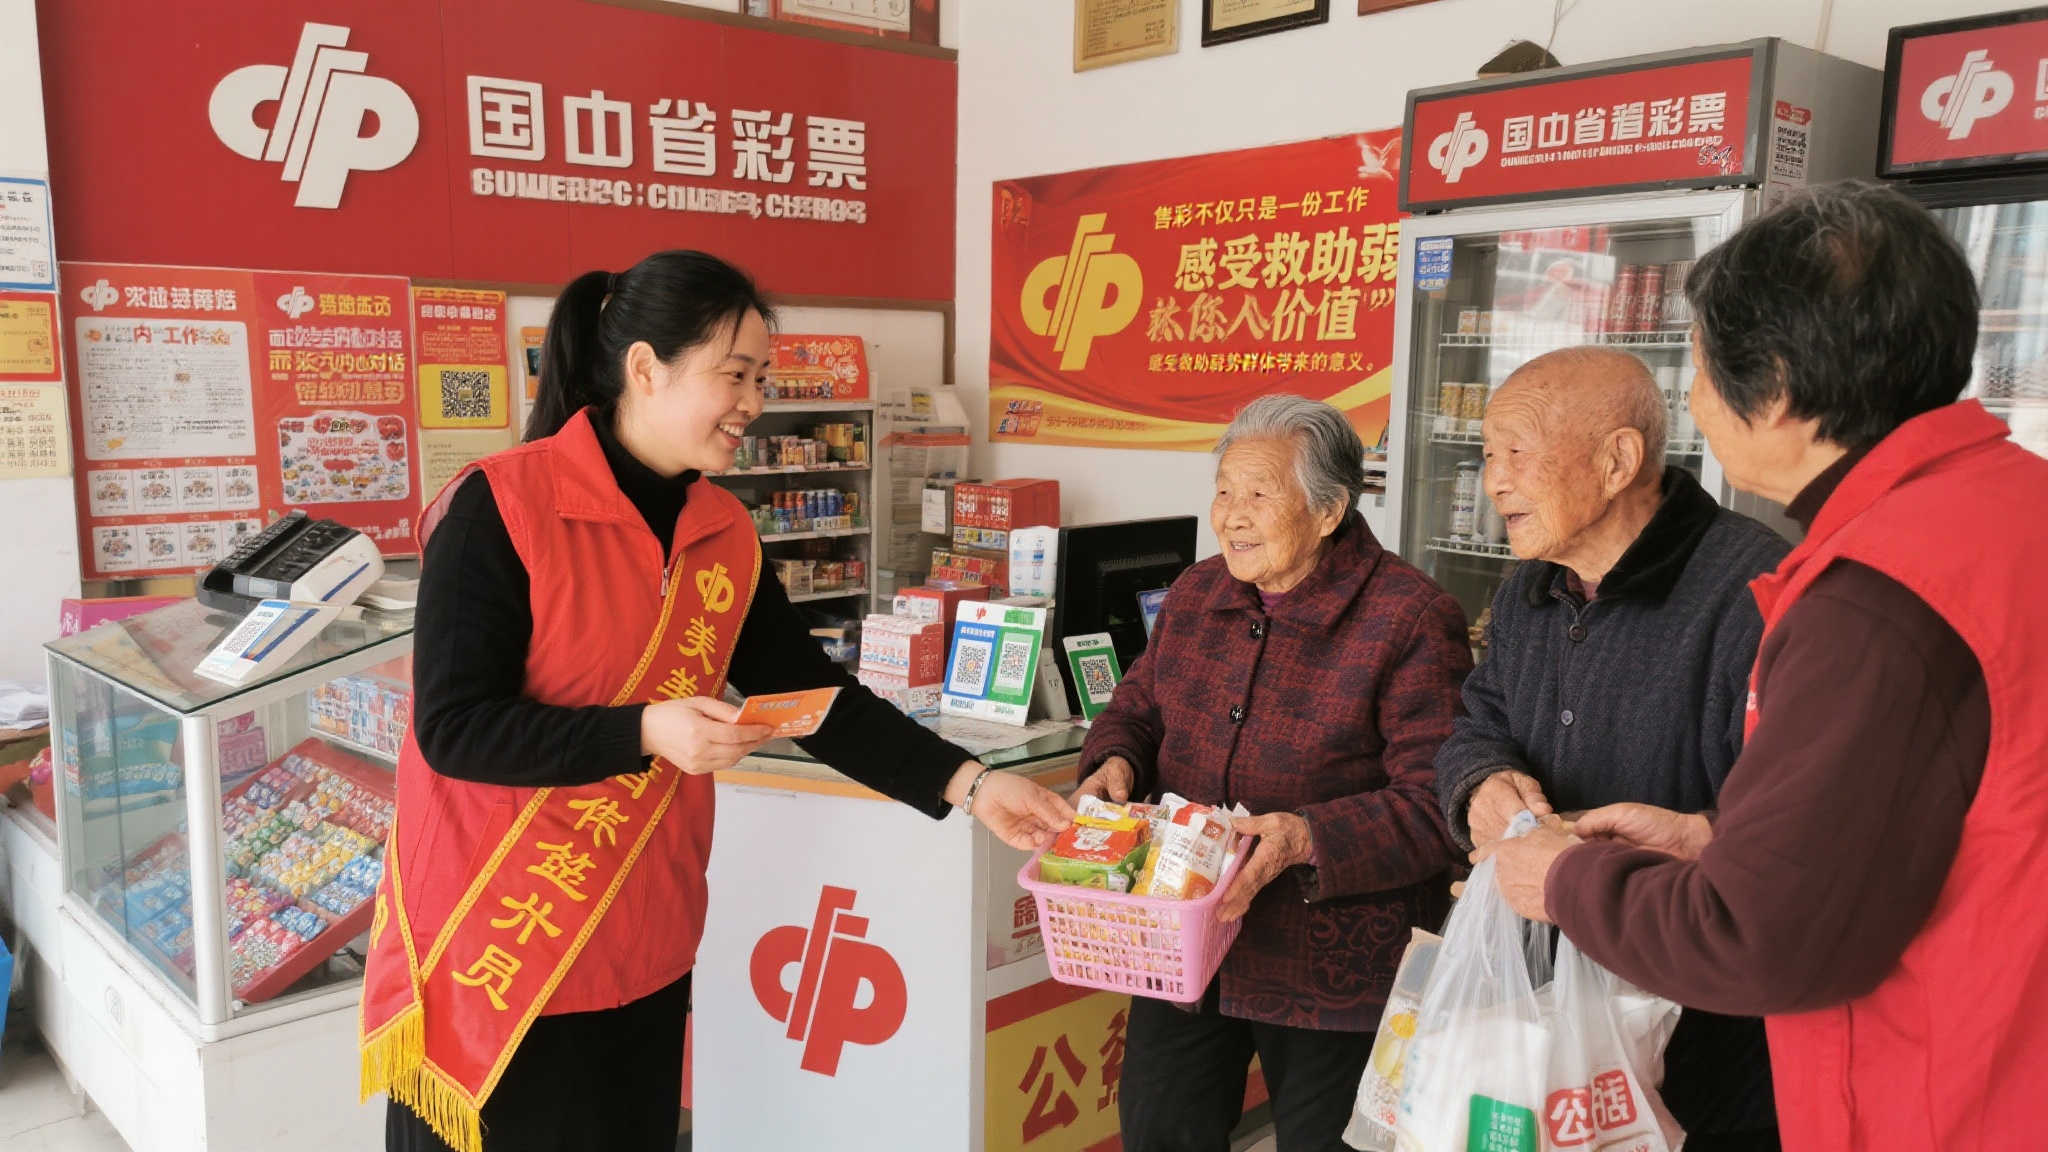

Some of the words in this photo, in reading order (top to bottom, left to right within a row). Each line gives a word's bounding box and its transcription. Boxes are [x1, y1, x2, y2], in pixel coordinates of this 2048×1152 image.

[467, 75, 867, 191] 国中省彩票
[1174, 222, 1400, 292] 感受救助弱
